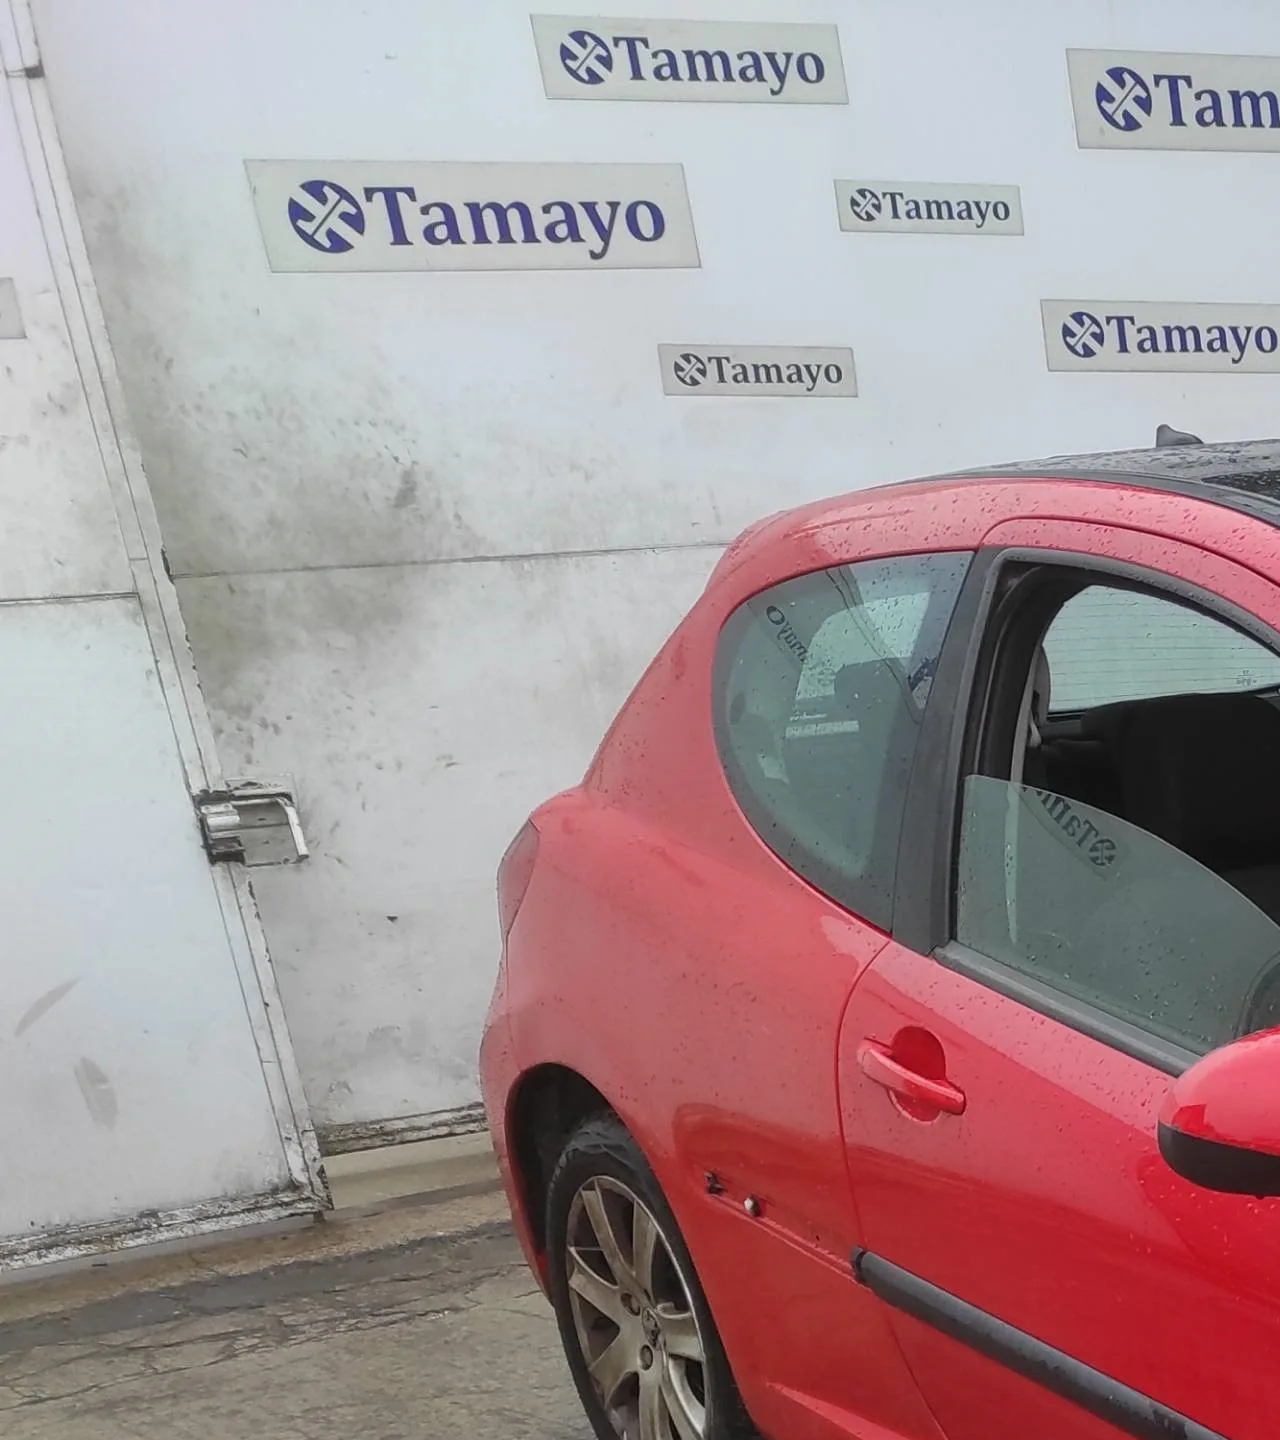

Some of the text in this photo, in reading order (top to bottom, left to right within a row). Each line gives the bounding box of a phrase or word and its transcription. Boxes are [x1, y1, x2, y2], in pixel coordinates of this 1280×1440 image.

[612, 36, 824, 96] Tamayo
[363, 187, 665, 260] Tamayo
[882, 192, 1010, 228] Tamayo
[1105, 316, 1277, 364] Tamayo
[707, 356, 842, 392] Tamayo
